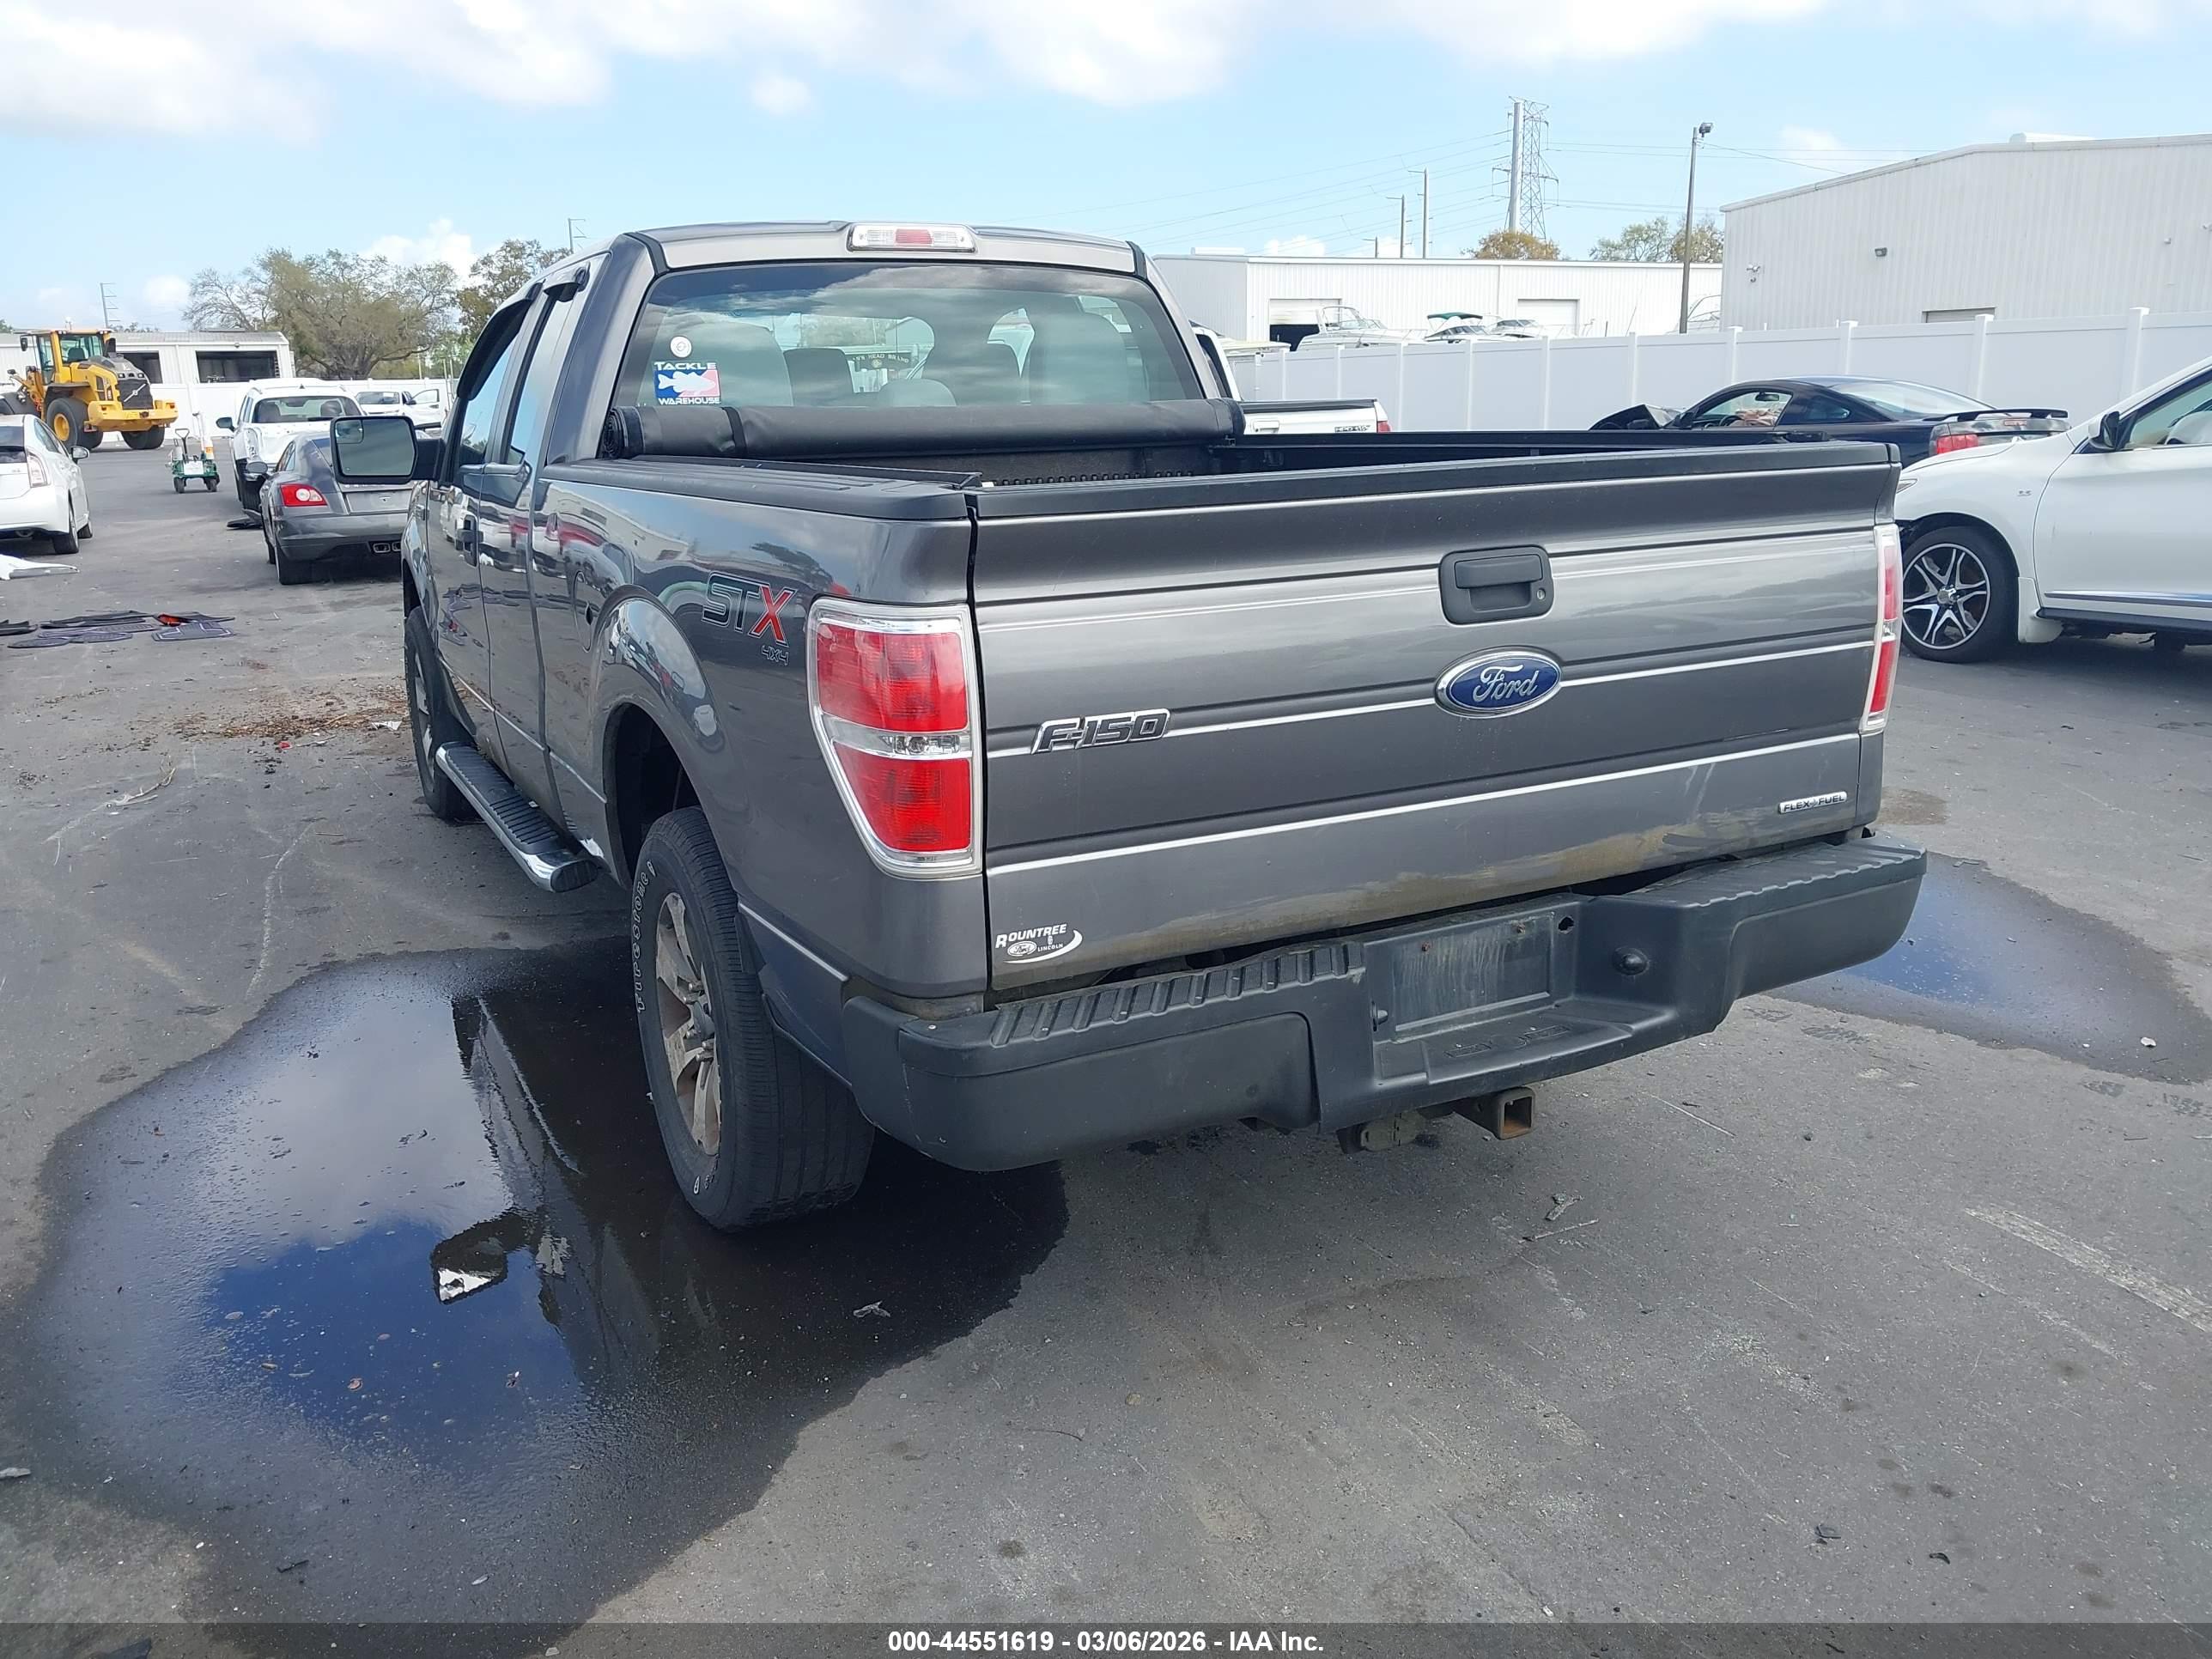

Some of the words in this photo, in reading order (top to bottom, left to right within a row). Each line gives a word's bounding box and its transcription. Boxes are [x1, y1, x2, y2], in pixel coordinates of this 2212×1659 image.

[653, 362, 717, 371] TACKLE
[658, 397, 721, 405] WAREHOUSE
[701, 569, 799, 647] STX
[1472, 664, 1540, 702] Ford
[1031, 708, 1170, 755] F-150
[1783, 800, 1810, 812] FLEX
[1818, 794, 1844, 805] FUEL
[994, 923, 1067, 949] ROUNTREE
[1037, 943, 1064, 952] LINCOLN
